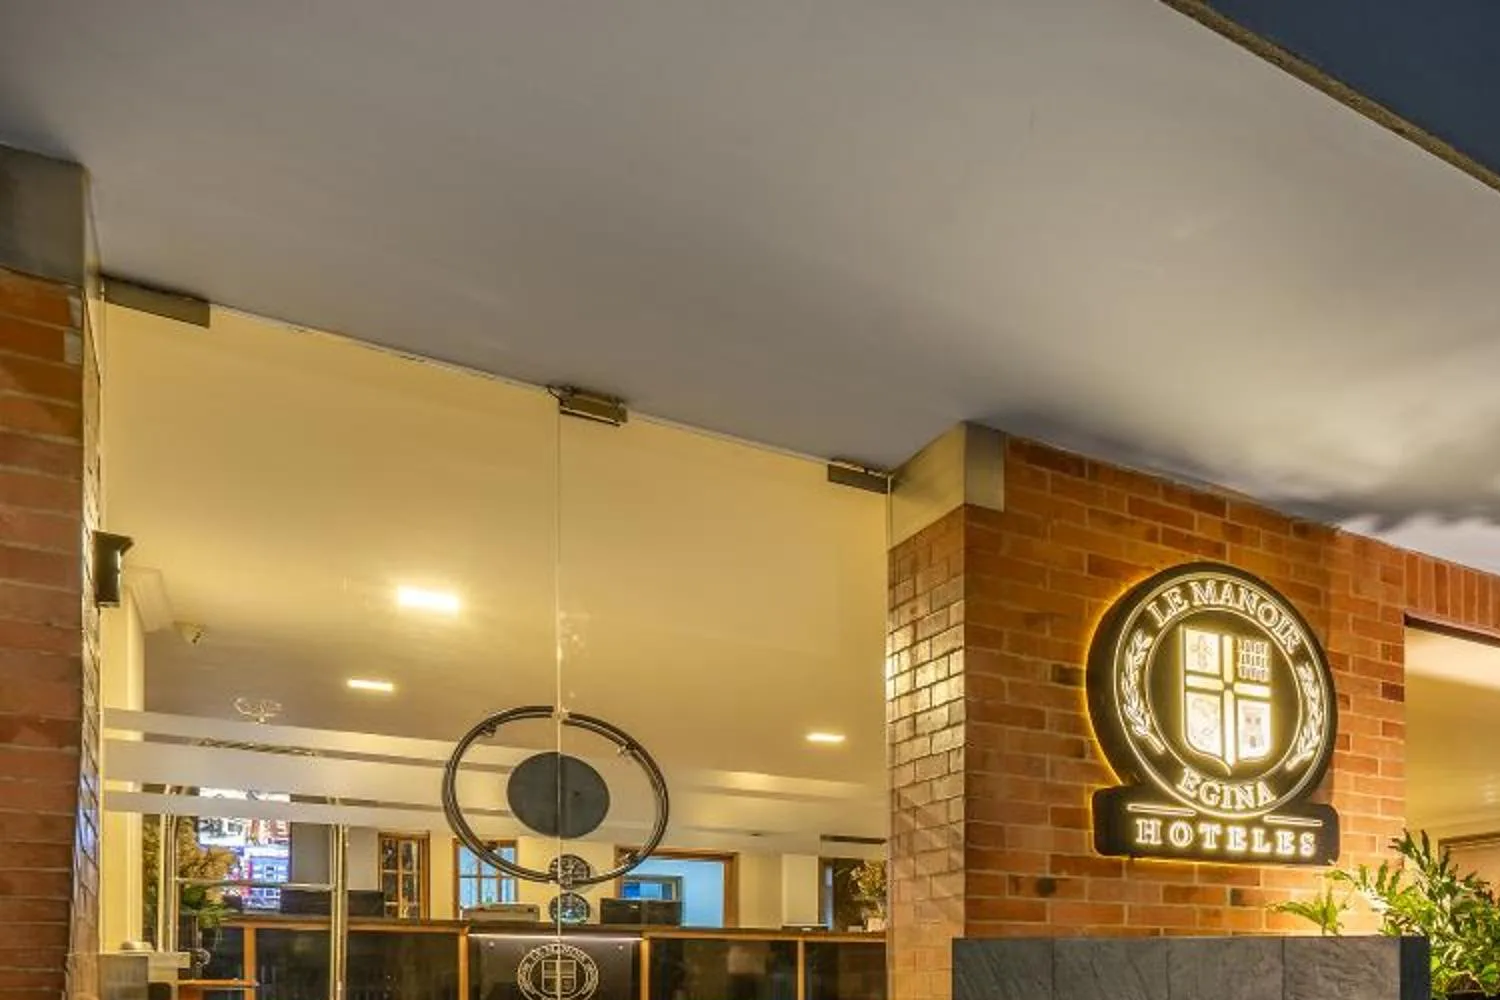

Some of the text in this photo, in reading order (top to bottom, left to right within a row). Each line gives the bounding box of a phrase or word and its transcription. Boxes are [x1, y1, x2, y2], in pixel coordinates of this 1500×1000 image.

[1147, 580, 1301, 654] LE MANOIR
[1176, 767, 1277, 810] EGINA
[1135, 819, 1317, 857] HOTELES
